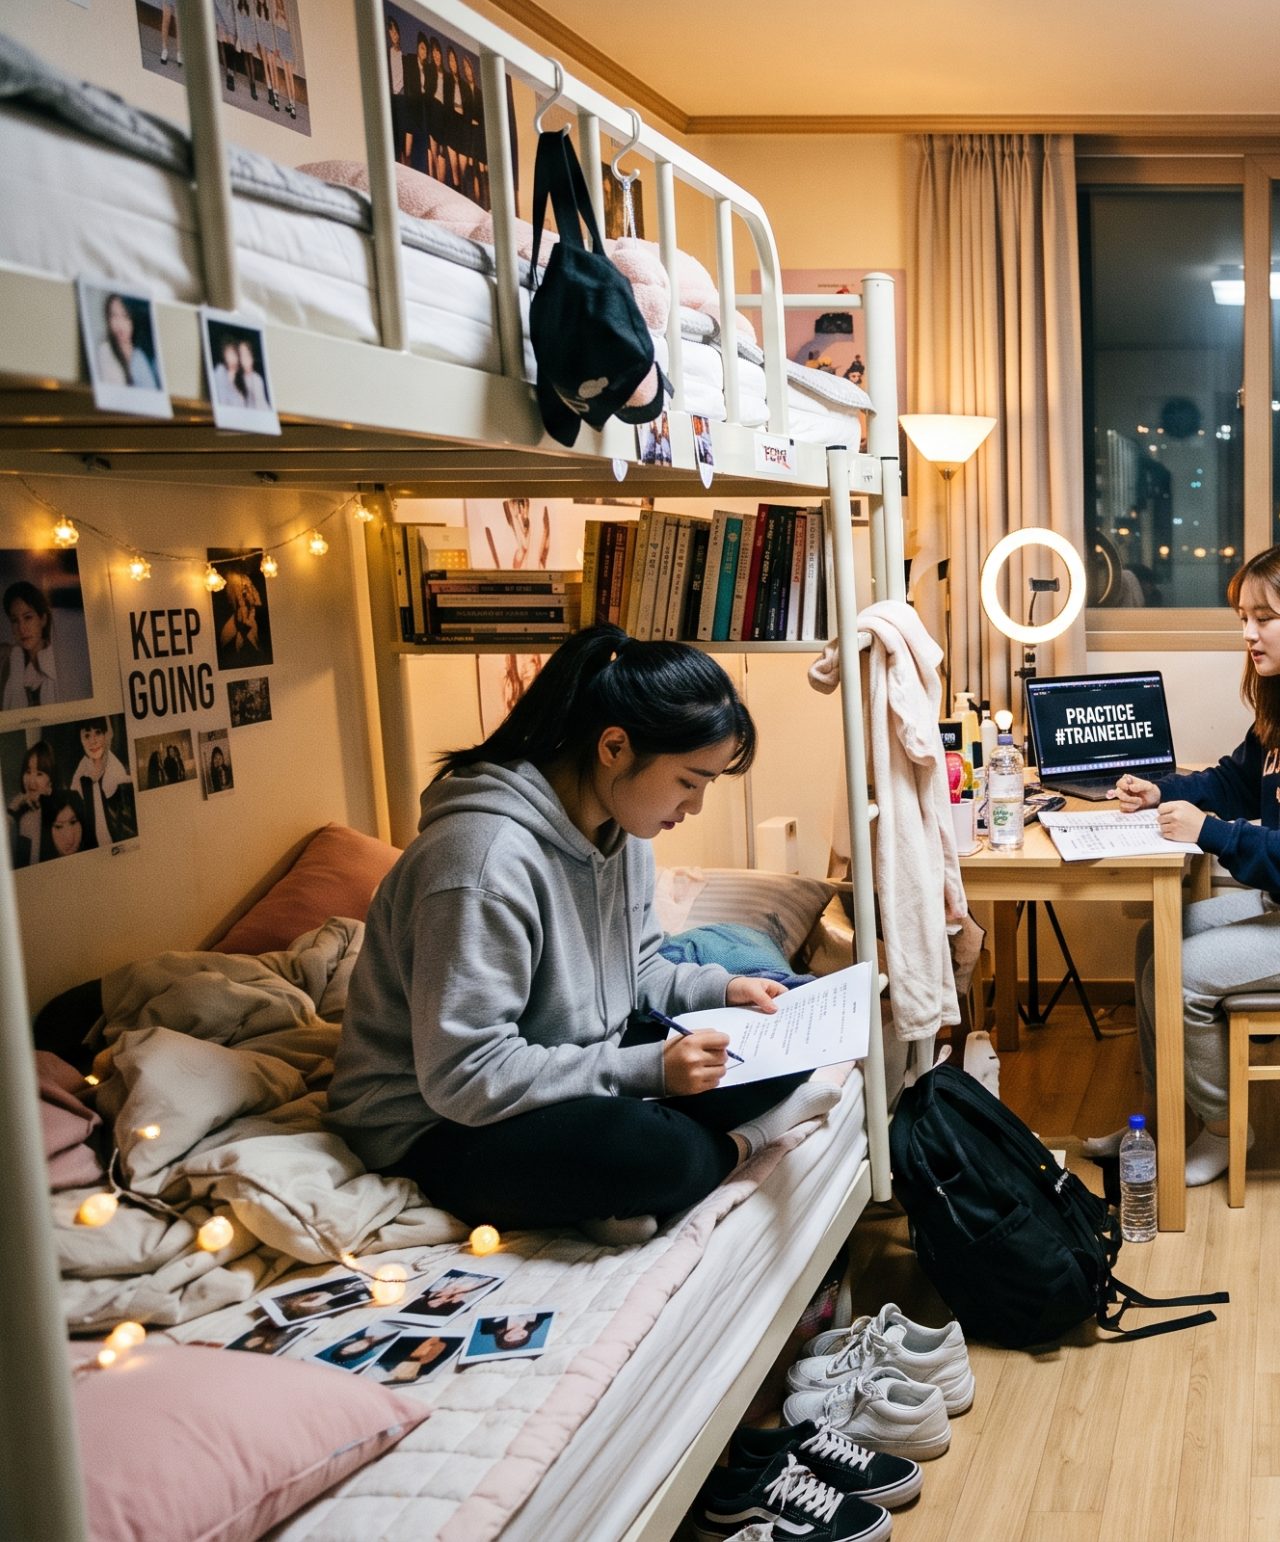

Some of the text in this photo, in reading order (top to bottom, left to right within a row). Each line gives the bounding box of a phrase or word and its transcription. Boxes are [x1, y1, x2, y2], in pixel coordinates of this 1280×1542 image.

[129, 608, 201, 660] KEEP
[128, 662, 215, 720] GOING
[1055, 721, 1154, 745] #TRAINEELIFE
[1066, 703, 1136, 725] PRACTICE
